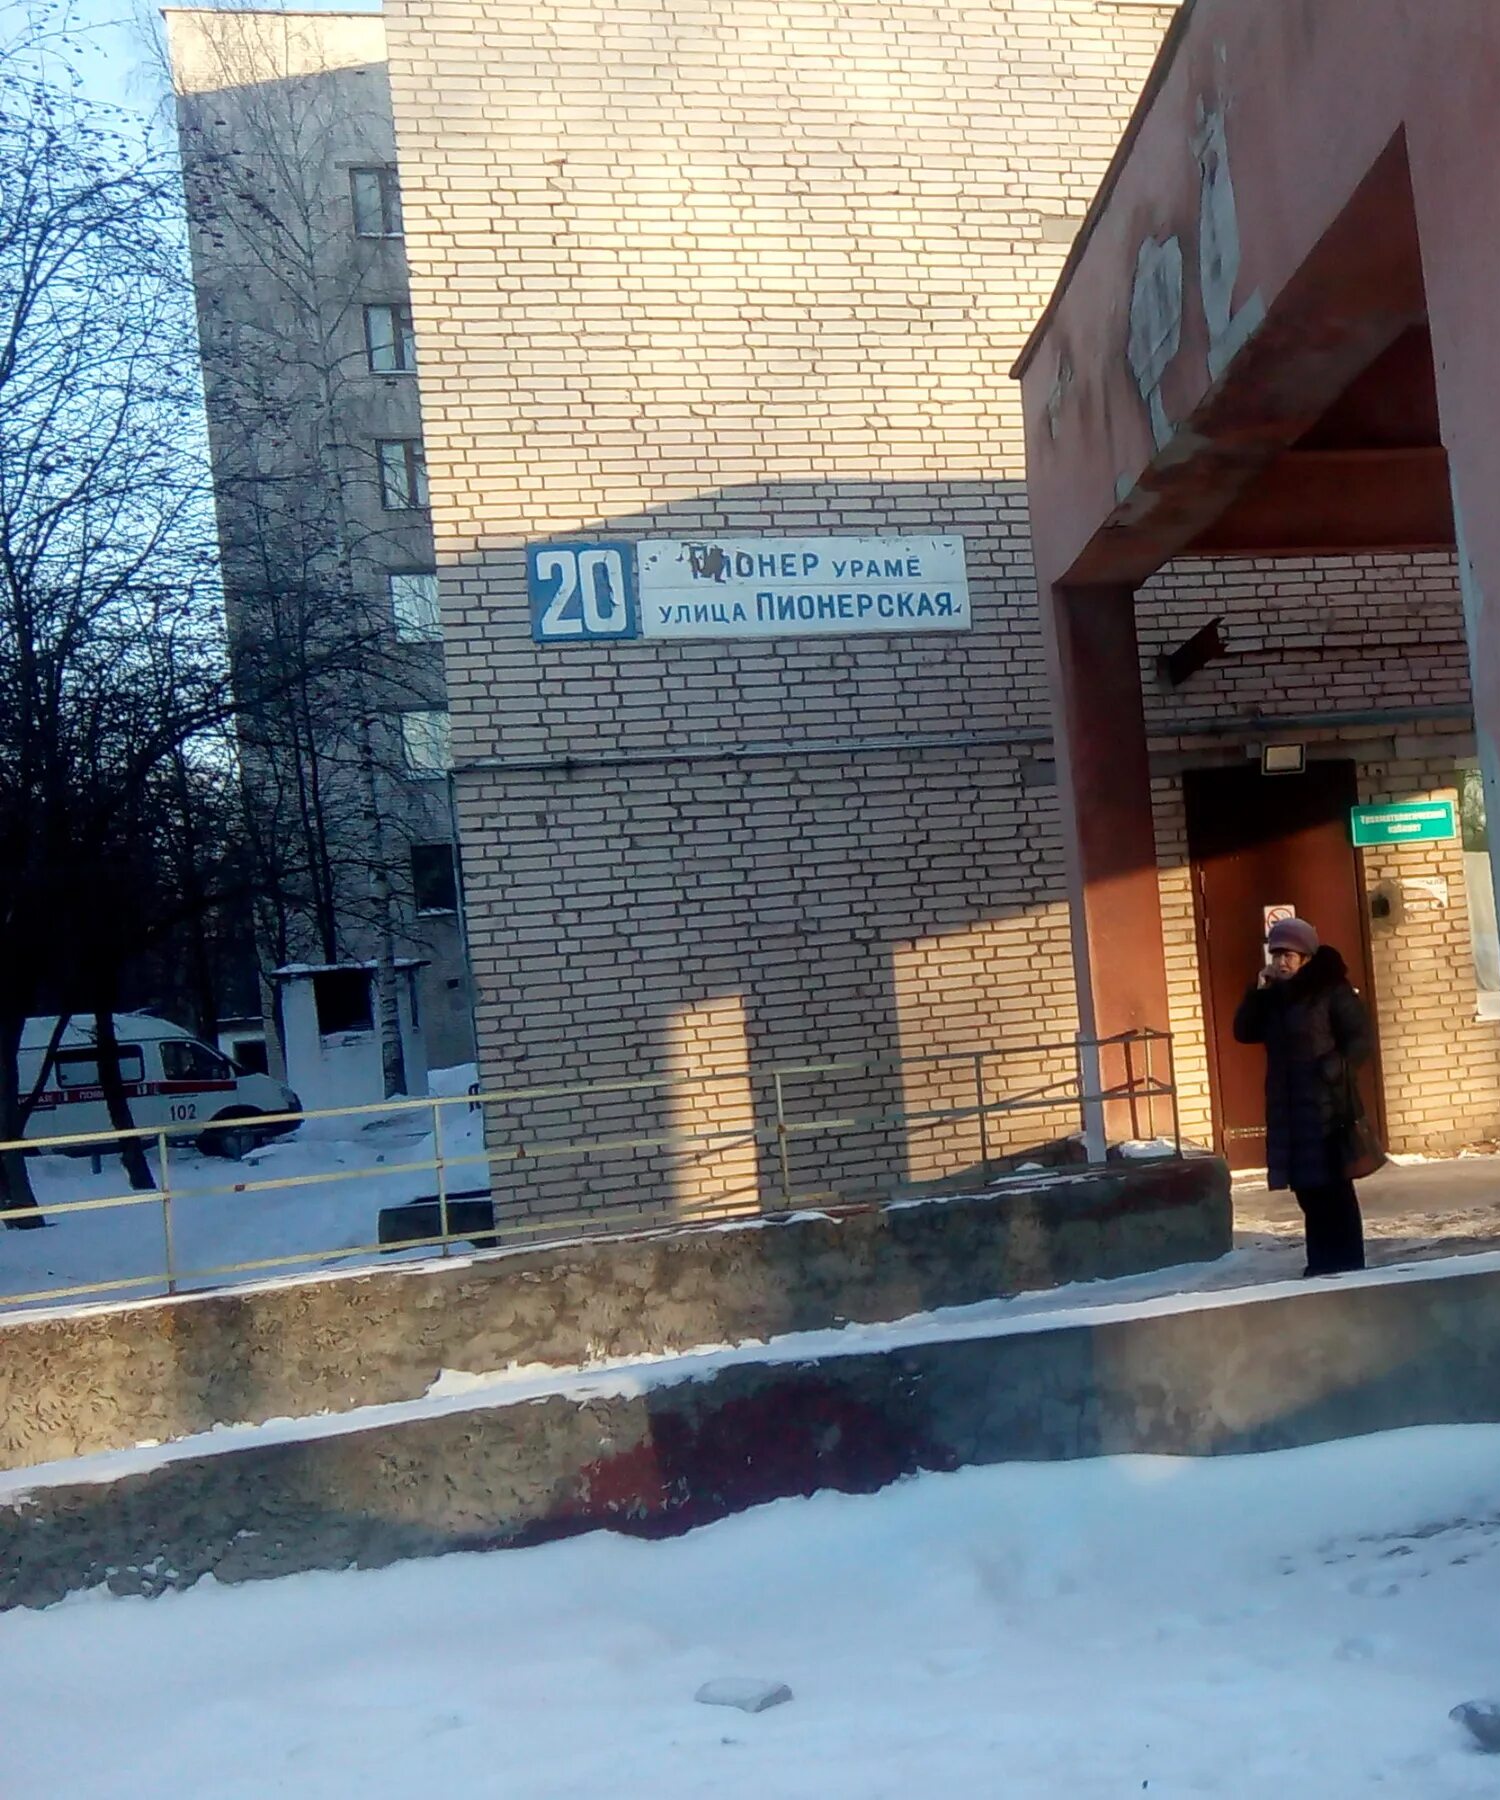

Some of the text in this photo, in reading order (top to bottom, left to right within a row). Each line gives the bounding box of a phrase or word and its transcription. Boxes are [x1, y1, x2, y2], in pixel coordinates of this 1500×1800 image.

[536, 549, 627, 635] 20
[659, 605, 746, 625] УЛИЦА
[170, 1103, 196, 1121] 102
